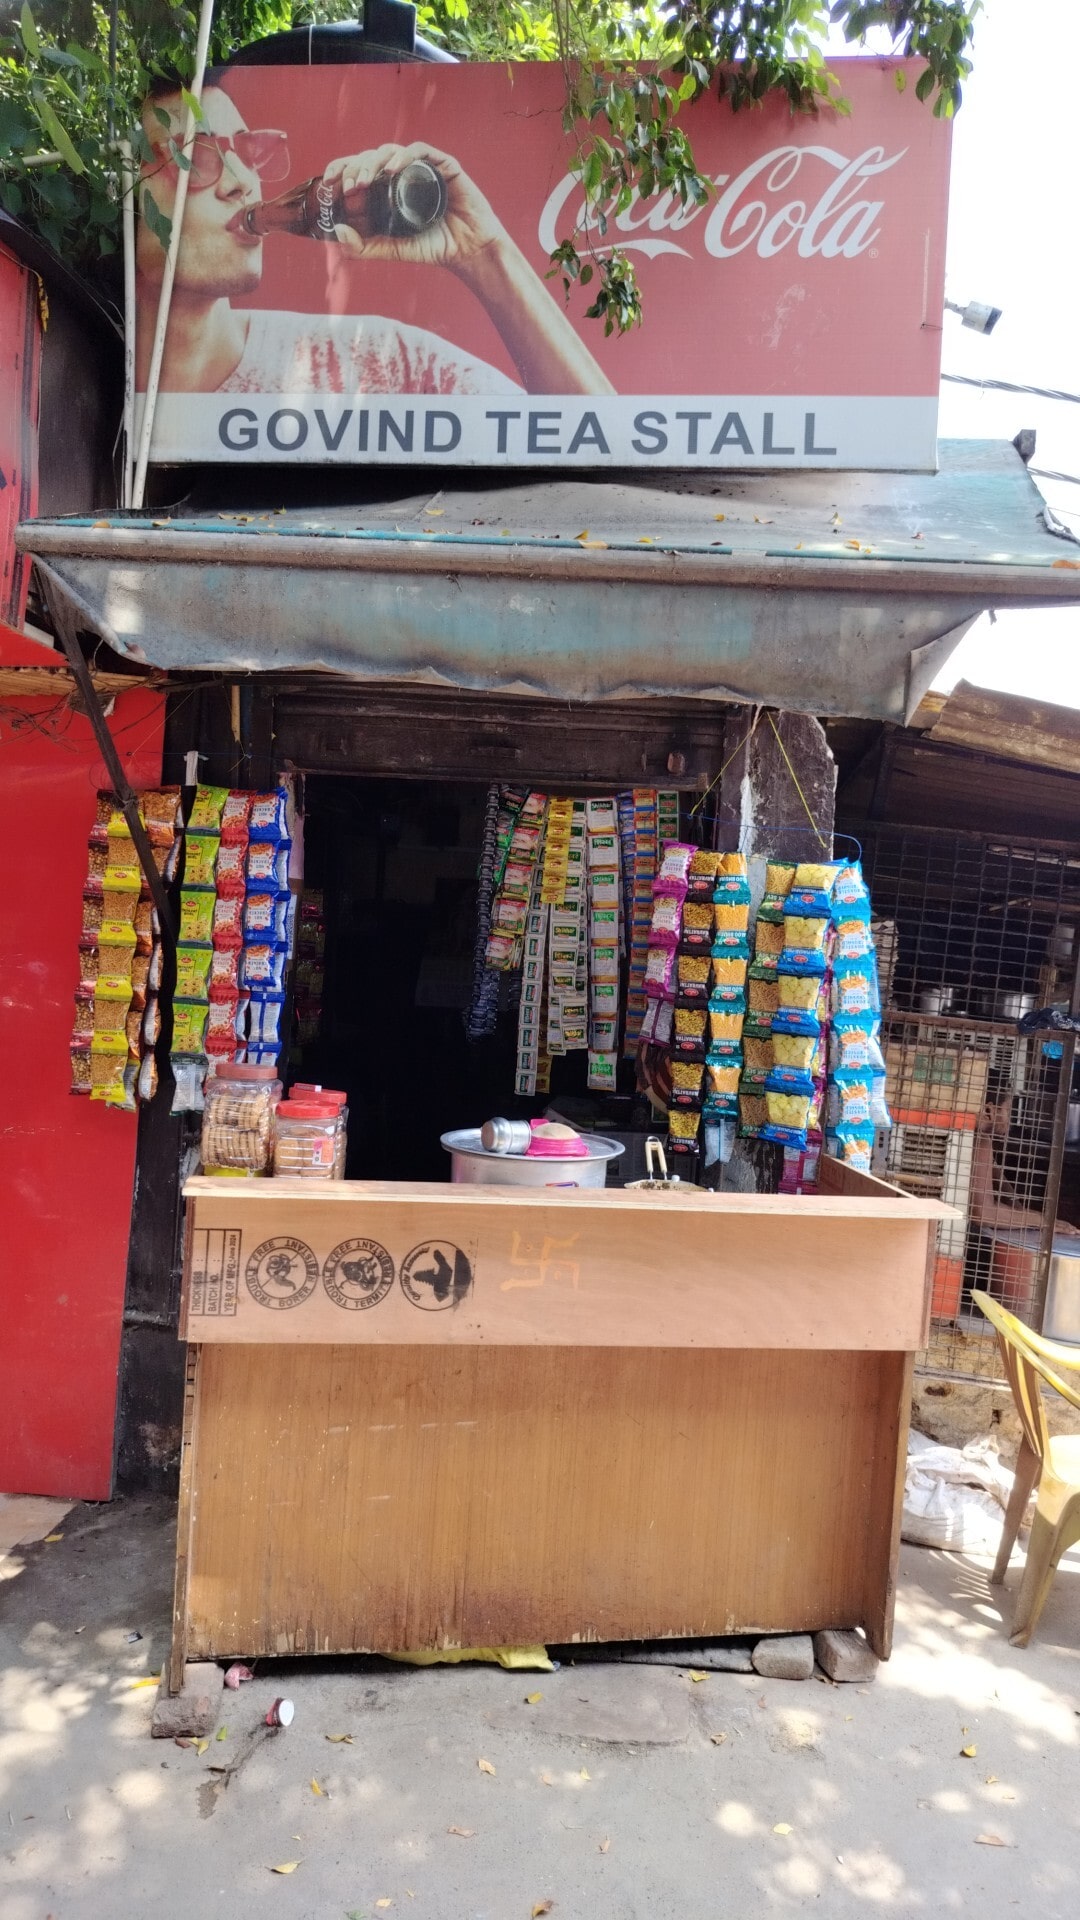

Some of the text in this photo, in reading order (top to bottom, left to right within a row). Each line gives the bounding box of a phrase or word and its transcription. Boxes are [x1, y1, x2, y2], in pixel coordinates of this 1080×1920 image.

[218, 408, 838, 456] GOVIND TEA STALL
[252, 1240, 276, 1262] FREE
[330, 1242, 352, 1263] FREE
[225, 1280, 235, 1291] OF
[208, 1287, 219, 1312] BATCH
[224, 1292, 235, 1312] YEAR
[278, 1286, 311, 1307] BORER
